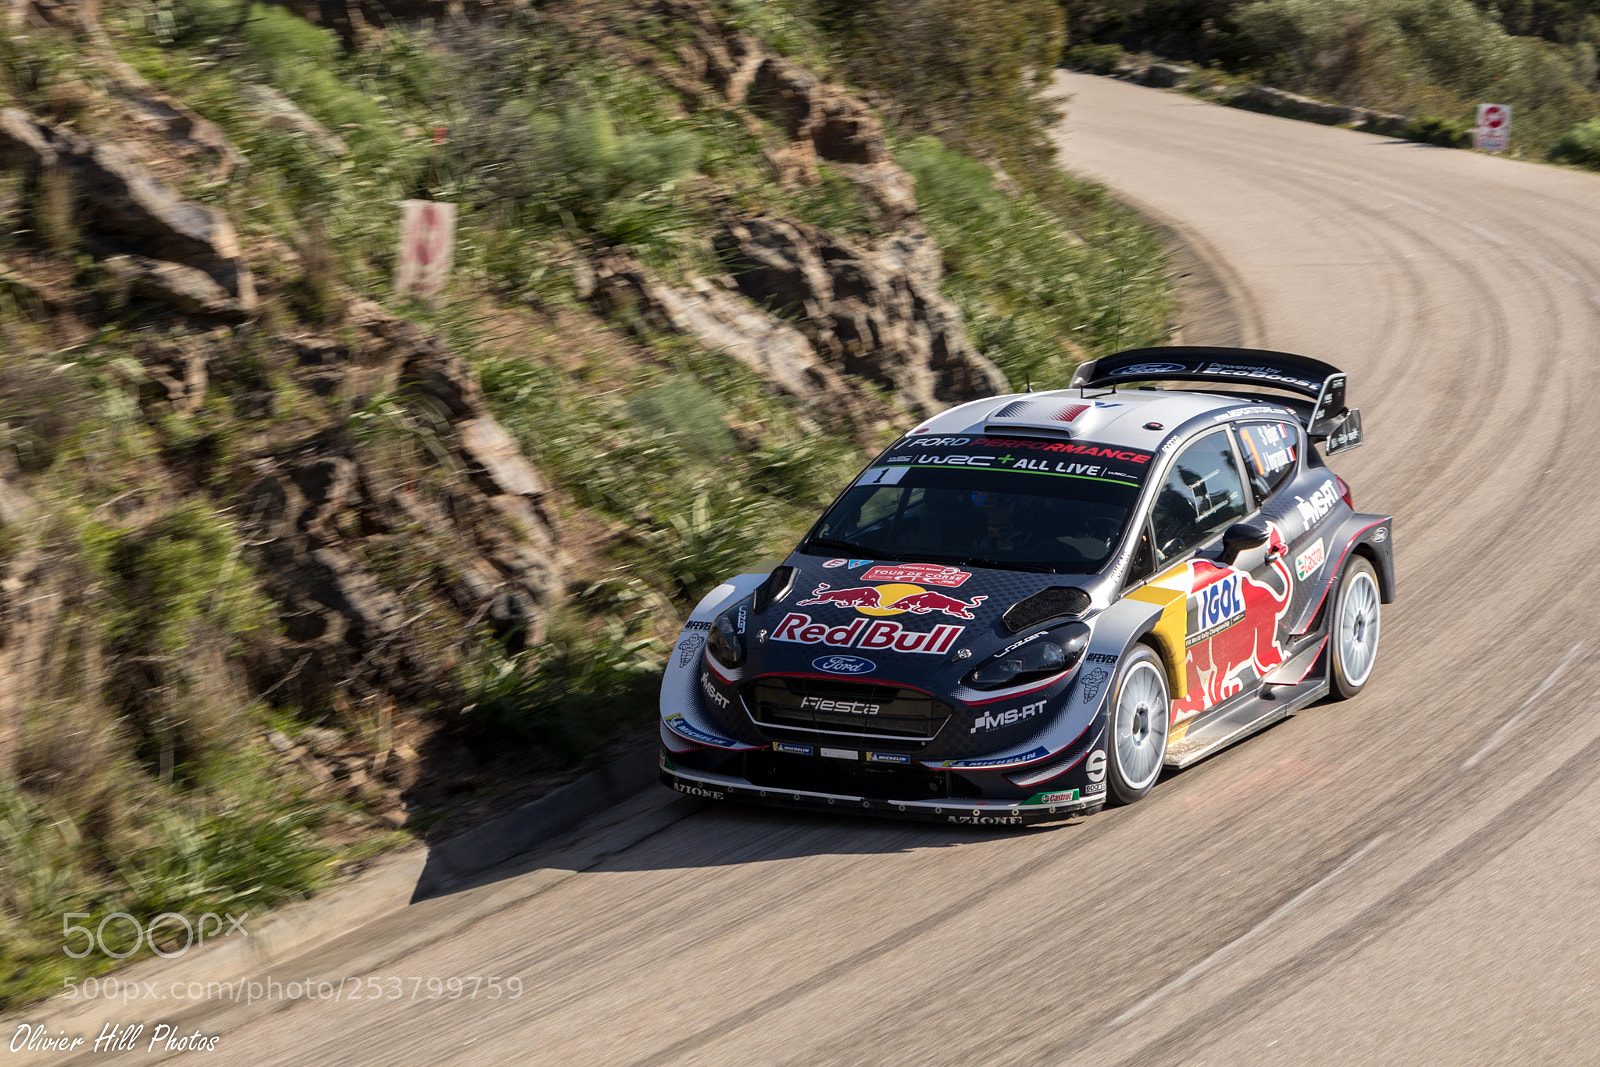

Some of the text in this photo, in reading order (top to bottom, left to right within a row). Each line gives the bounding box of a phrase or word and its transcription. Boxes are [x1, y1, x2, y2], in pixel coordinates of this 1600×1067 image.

[908, 437, 970, 448] FORD
[968, 437, 1151, 464] PERFORMANCE
[872, 467, 890, 484] 1
[1013, 458, 1049, 471] ALL
[1055, 461, 1101, 476] LIVE
[925, 573, 963, 581] CORSE
[1202, 575, 1240, 629] IGOL
[769, 612, 966, 655] Red Bull
[821, 656, 865, 673] Ford
[1086, 652, 1119, 664] #FEVER
[800, 696, 880, 715] Fiesta
[985, 699, 1048, 730] MS-RT
[783, 745, 810, 753] MICHELIN
[968, 752, 1036, 767] MICHELIN
[1049, 792, 1072, 803] Castrol
